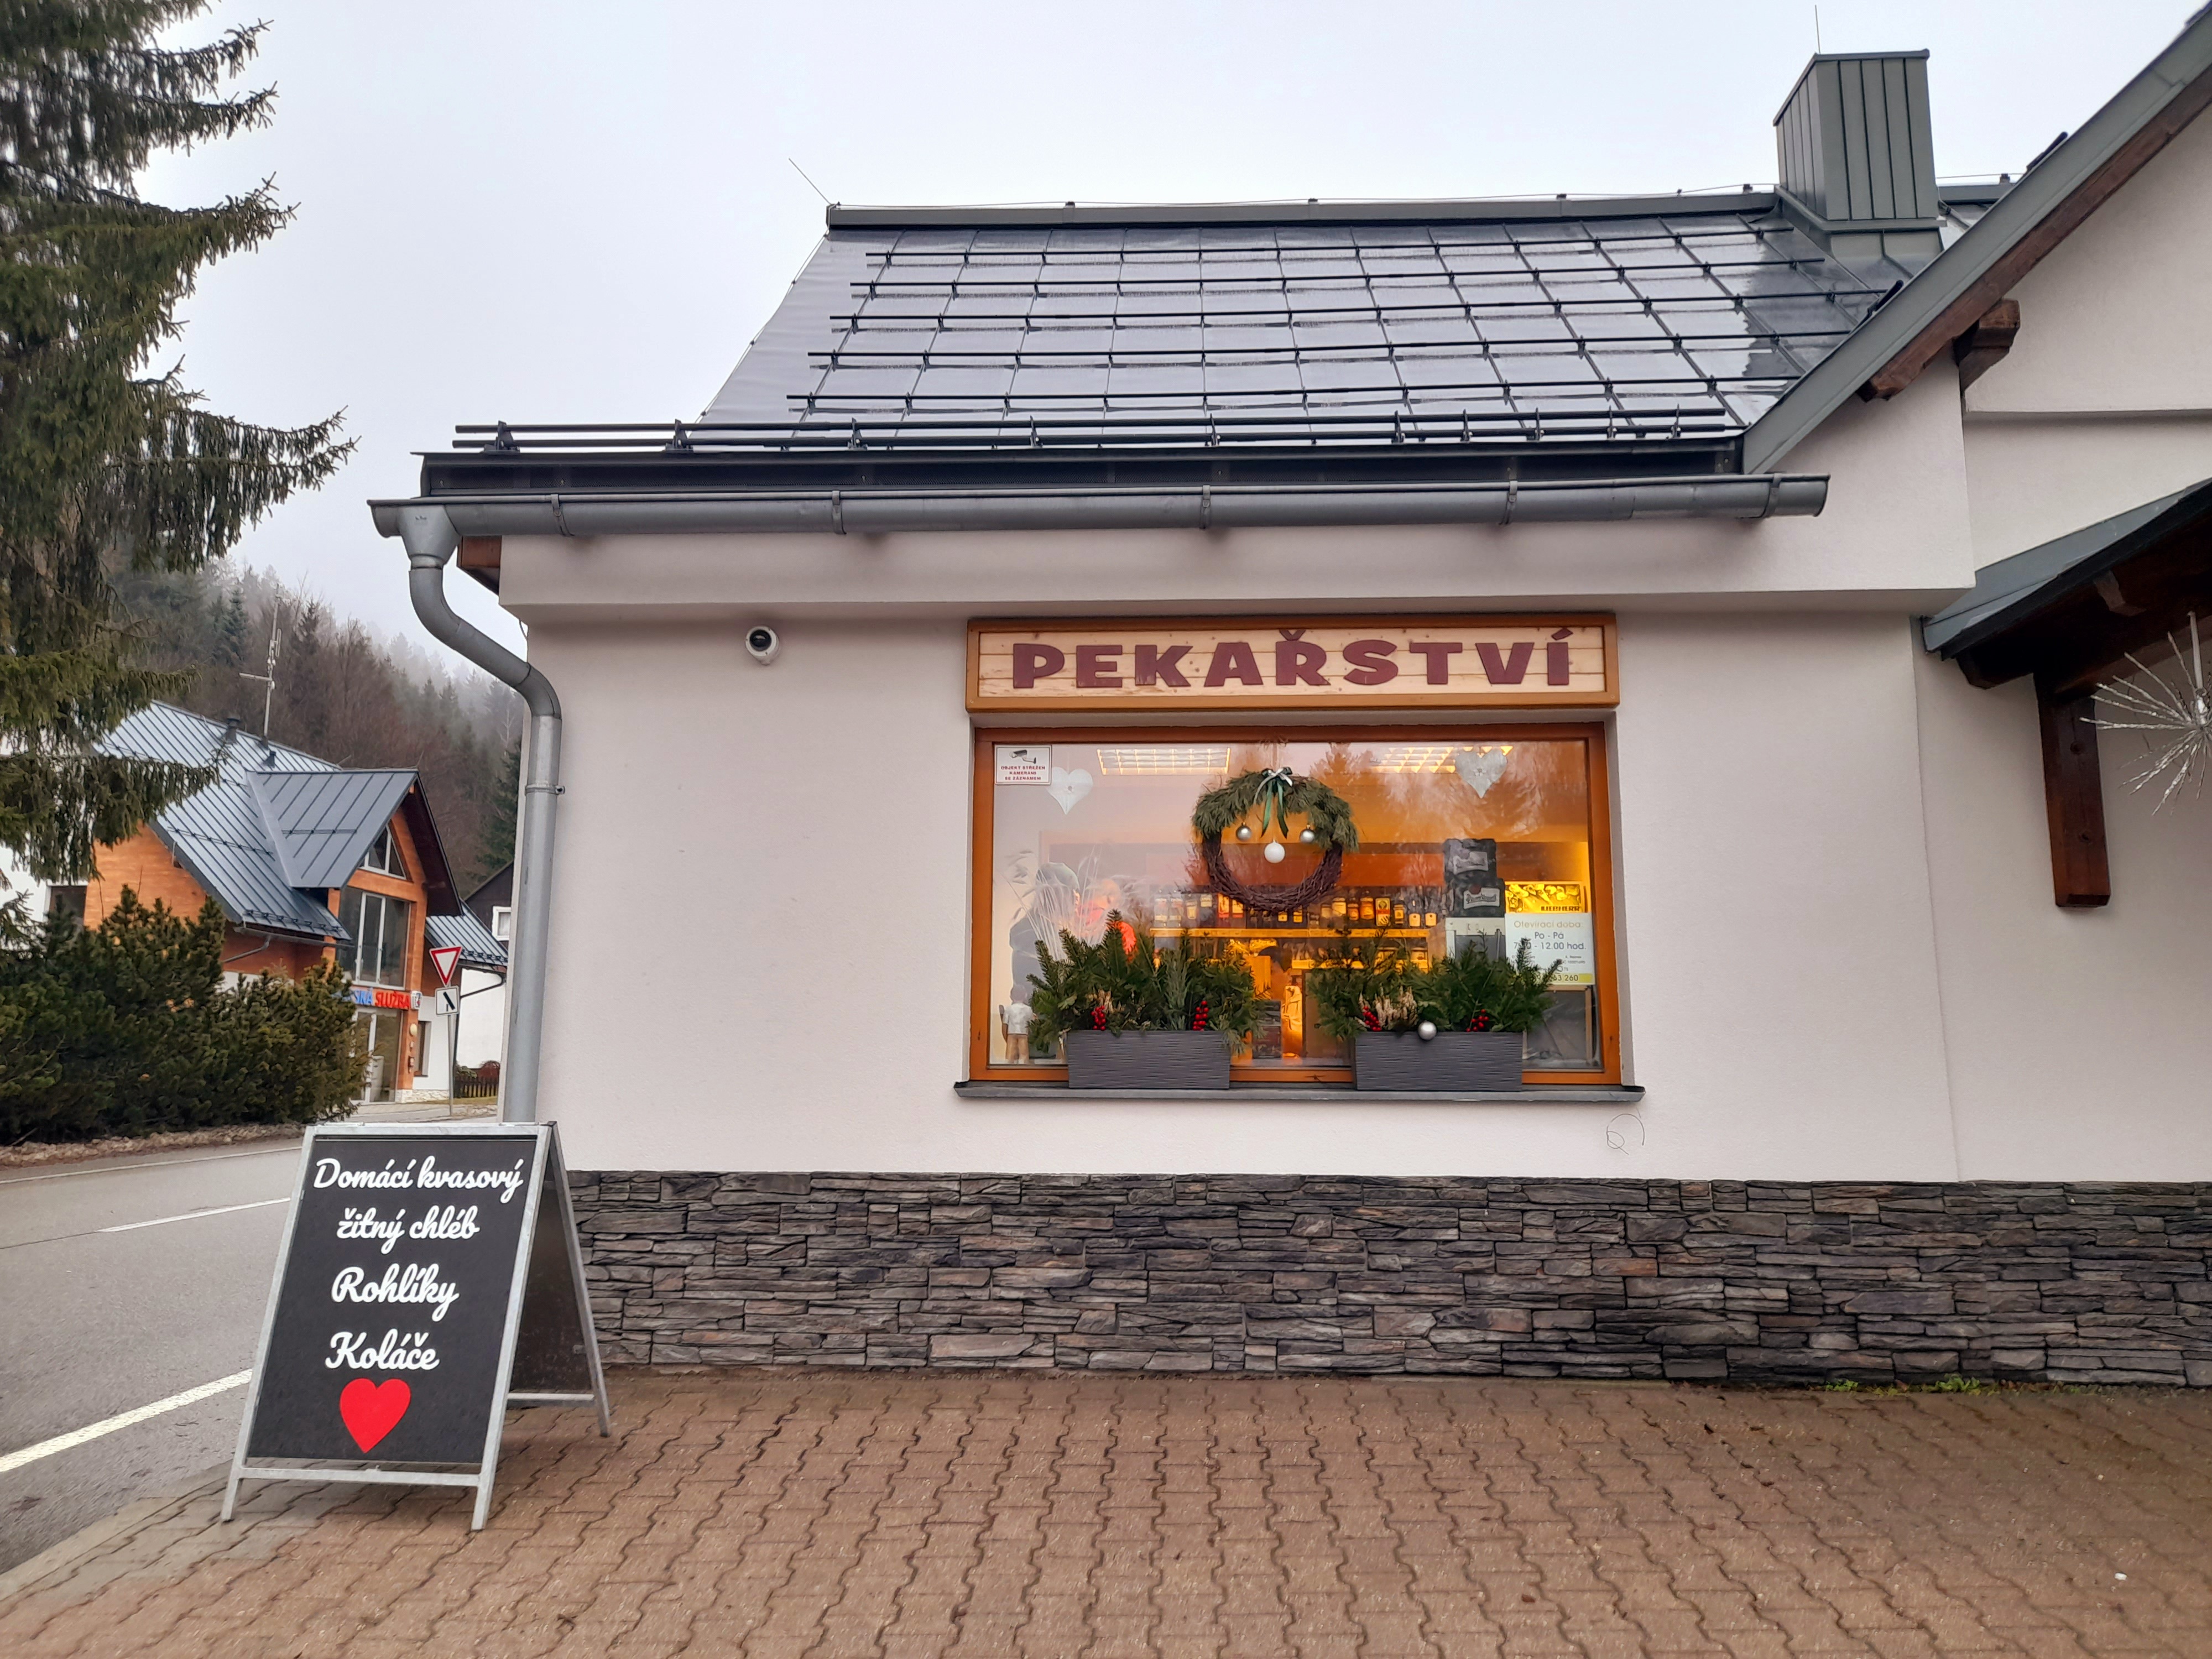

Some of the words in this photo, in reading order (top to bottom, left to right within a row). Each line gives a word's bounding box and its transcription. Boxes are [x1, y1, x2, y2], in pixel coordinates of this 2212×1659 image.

[1012, 628, 1572, 688] PEKAŘSTVÍ
[314, 1158, 416, 1188] Domácí
[417, 1156, 524, 1204] kvasový
[336, 1208, 405, 1254] žitný
[409, 1206, 480, 1240] chléb
[332, 1263, 460, 1322] Rohlíky
[325, 1329, 440, 1370] Koláče
